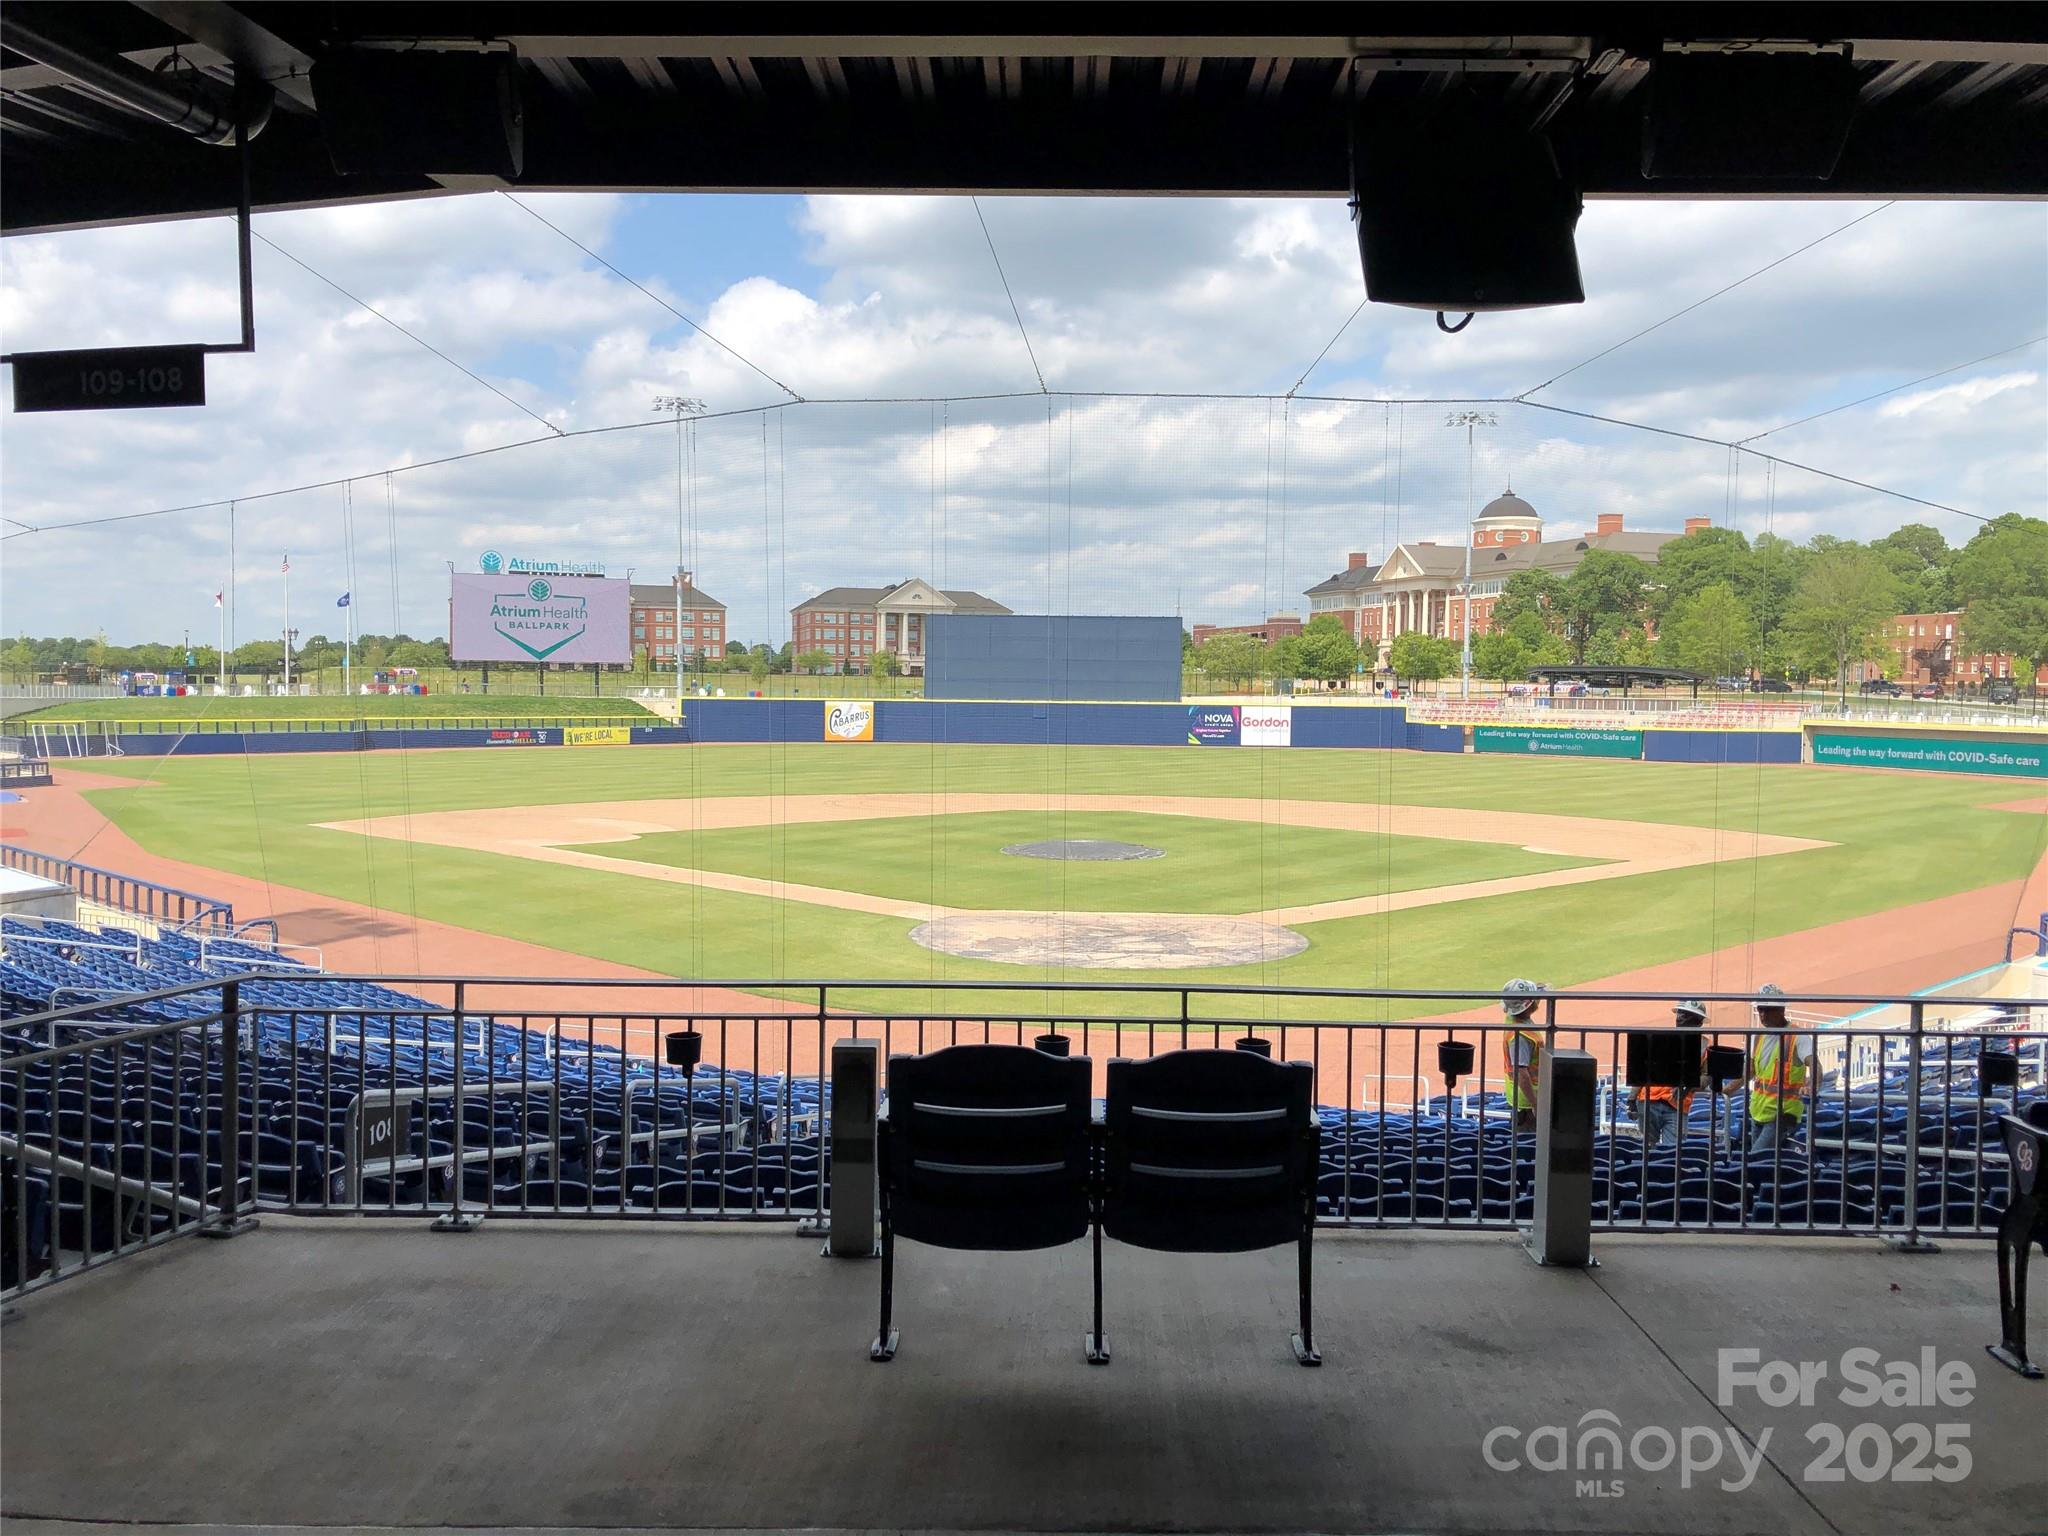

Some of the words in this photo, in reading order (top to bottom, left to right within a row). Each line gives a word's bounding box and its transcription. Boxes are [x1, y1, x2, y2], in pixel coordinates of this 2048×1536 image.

[80, 367, 184, 395] 109-108
[508, 557, 559, 571] Atrium
[561, 560, 606, 573] Health
[490, 604, 541, 618] Atrium
[543, 606, 588, 619] Health
[509, 621, 570, 630] BALLPARK
[1204, 714, 1234, 723] NOVA
[1242, 716, 1289, 728] Gordon
[594, 729, 613, 741] LOCAL
[1479, 729, 1505, 738] Leading
[1575, 732, 1620, 741] COVID-Safe
[1540, 742, 1562, 750] Atrium
[1562, 743, 1583, 751] Health
[1818, 744, 1852, 758] Leading
[1853, 746, 1867, 756] the
[1869, 749, 1886, 759] way
[1888, 747, 1923, 760] forward
[1926, 750, 1946, 761] with
[1948, 751, 2014, 765] COVID-Safe
[2016, 757, 2040, 766] care
